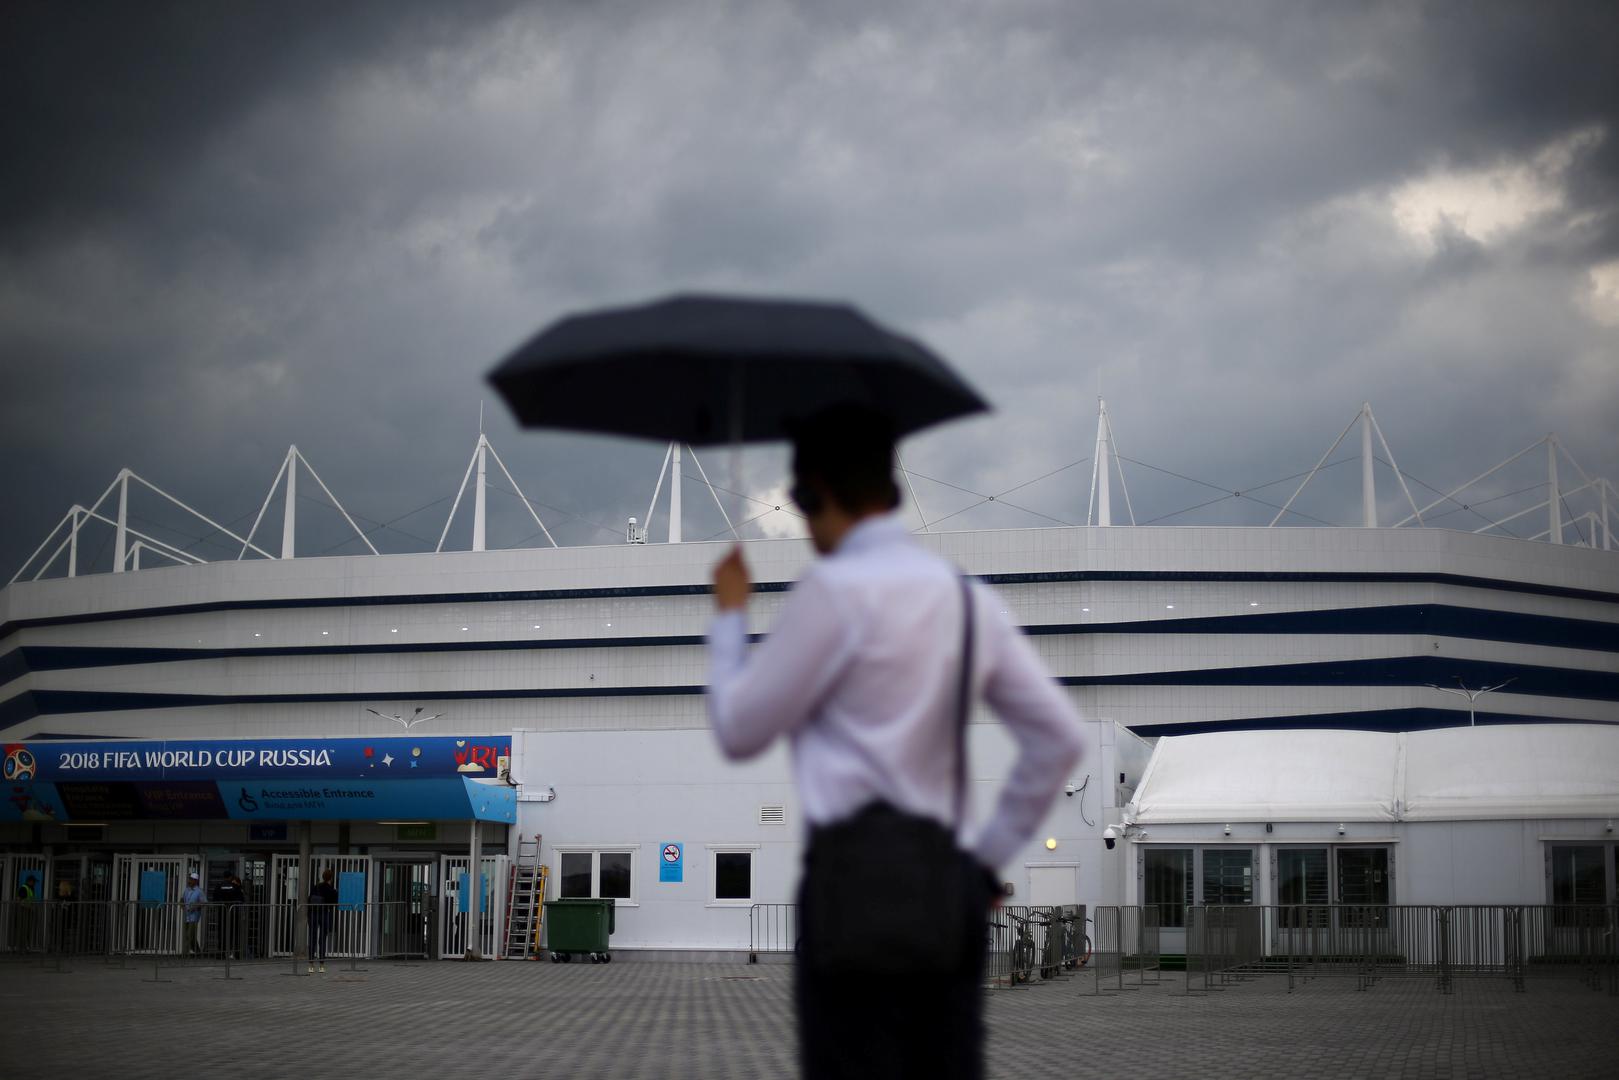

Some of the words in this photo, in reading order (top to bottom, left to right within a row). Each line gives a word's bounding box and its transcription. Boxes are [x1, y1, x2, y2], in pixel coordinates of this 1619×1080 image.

[58, 752, 98, 769] 2018
[103, 751, 141, 768] FIFA
[145, 750, 211, 768] WORLD
[215, 750, 255, 767] CUP
[258, 749, 331, 767] RUSSIA
[262, 787, 321, 799] Accessible
[322, 788, 375, 799] Entrance
